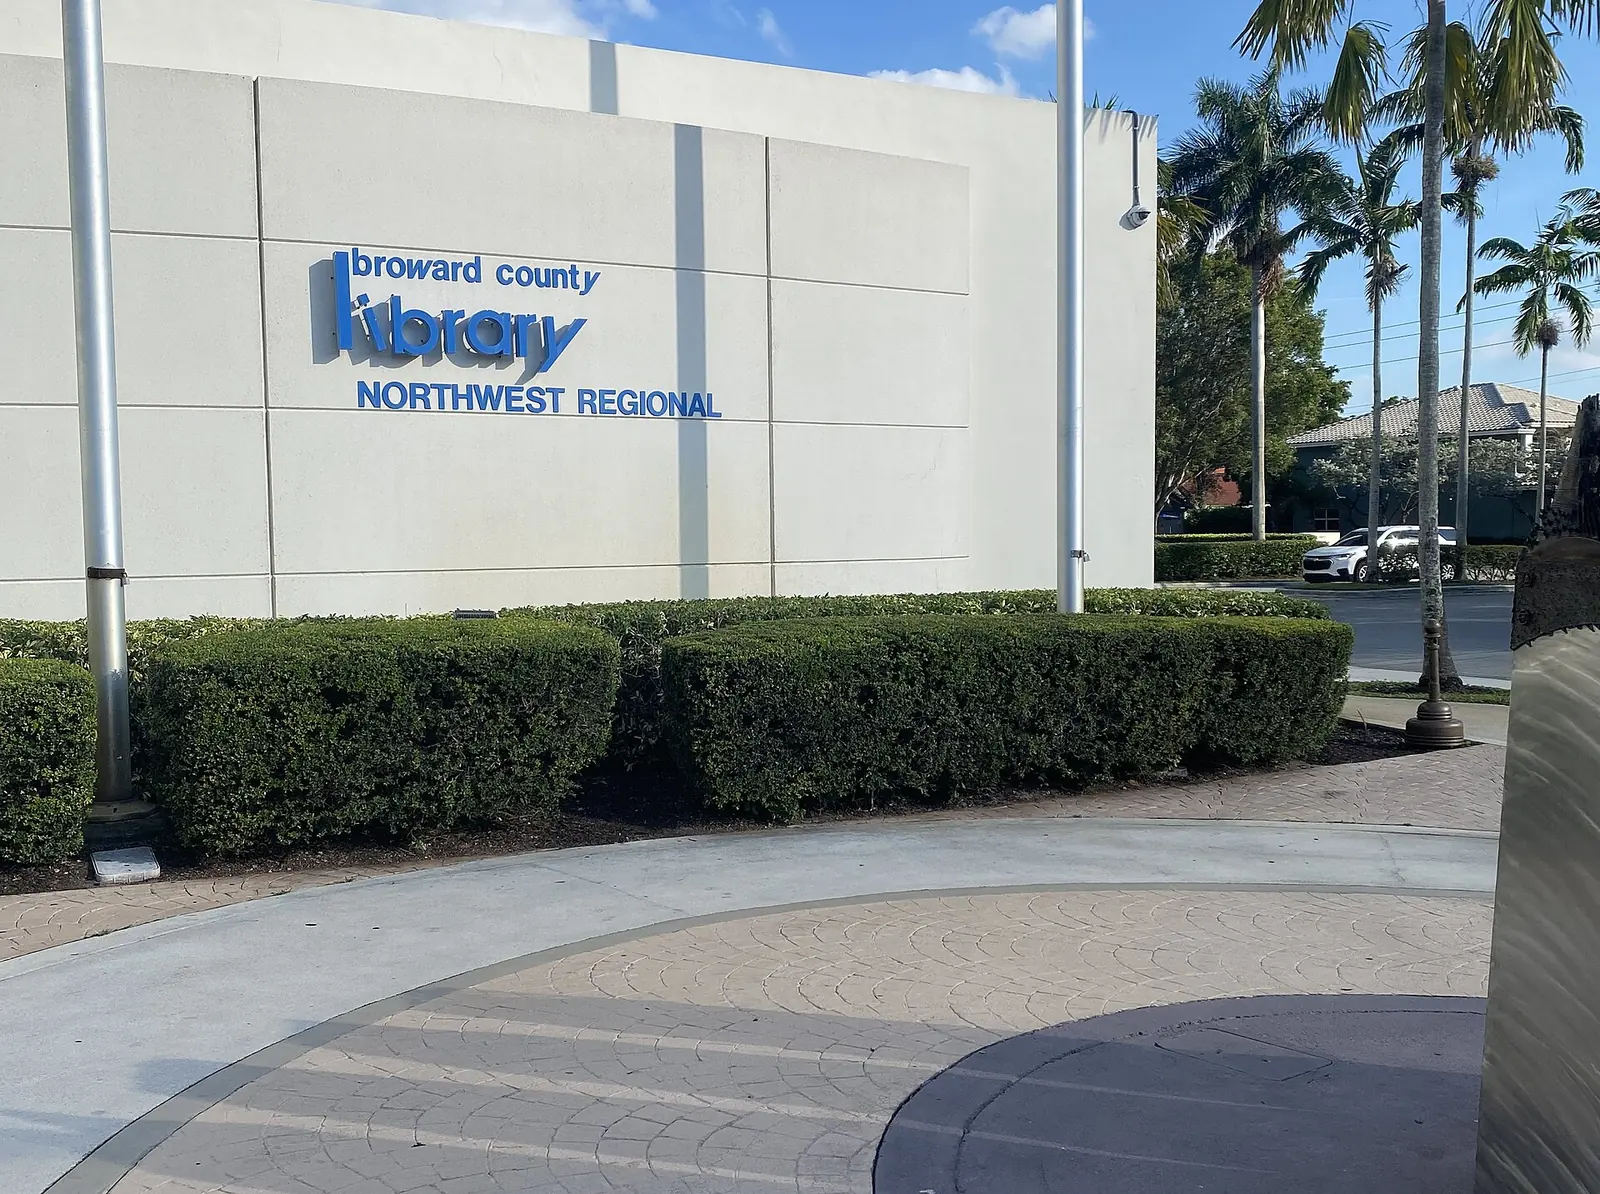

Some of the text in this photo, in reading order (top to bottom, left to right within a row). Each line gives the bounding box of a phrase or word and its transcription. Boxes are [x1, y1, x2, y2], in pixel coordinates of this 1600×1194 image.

[352, 248, 601, 296] broward county
[332, 251, 588, 373] library
[357, 381, 722, 418] NORTHWEST REGIONAL
